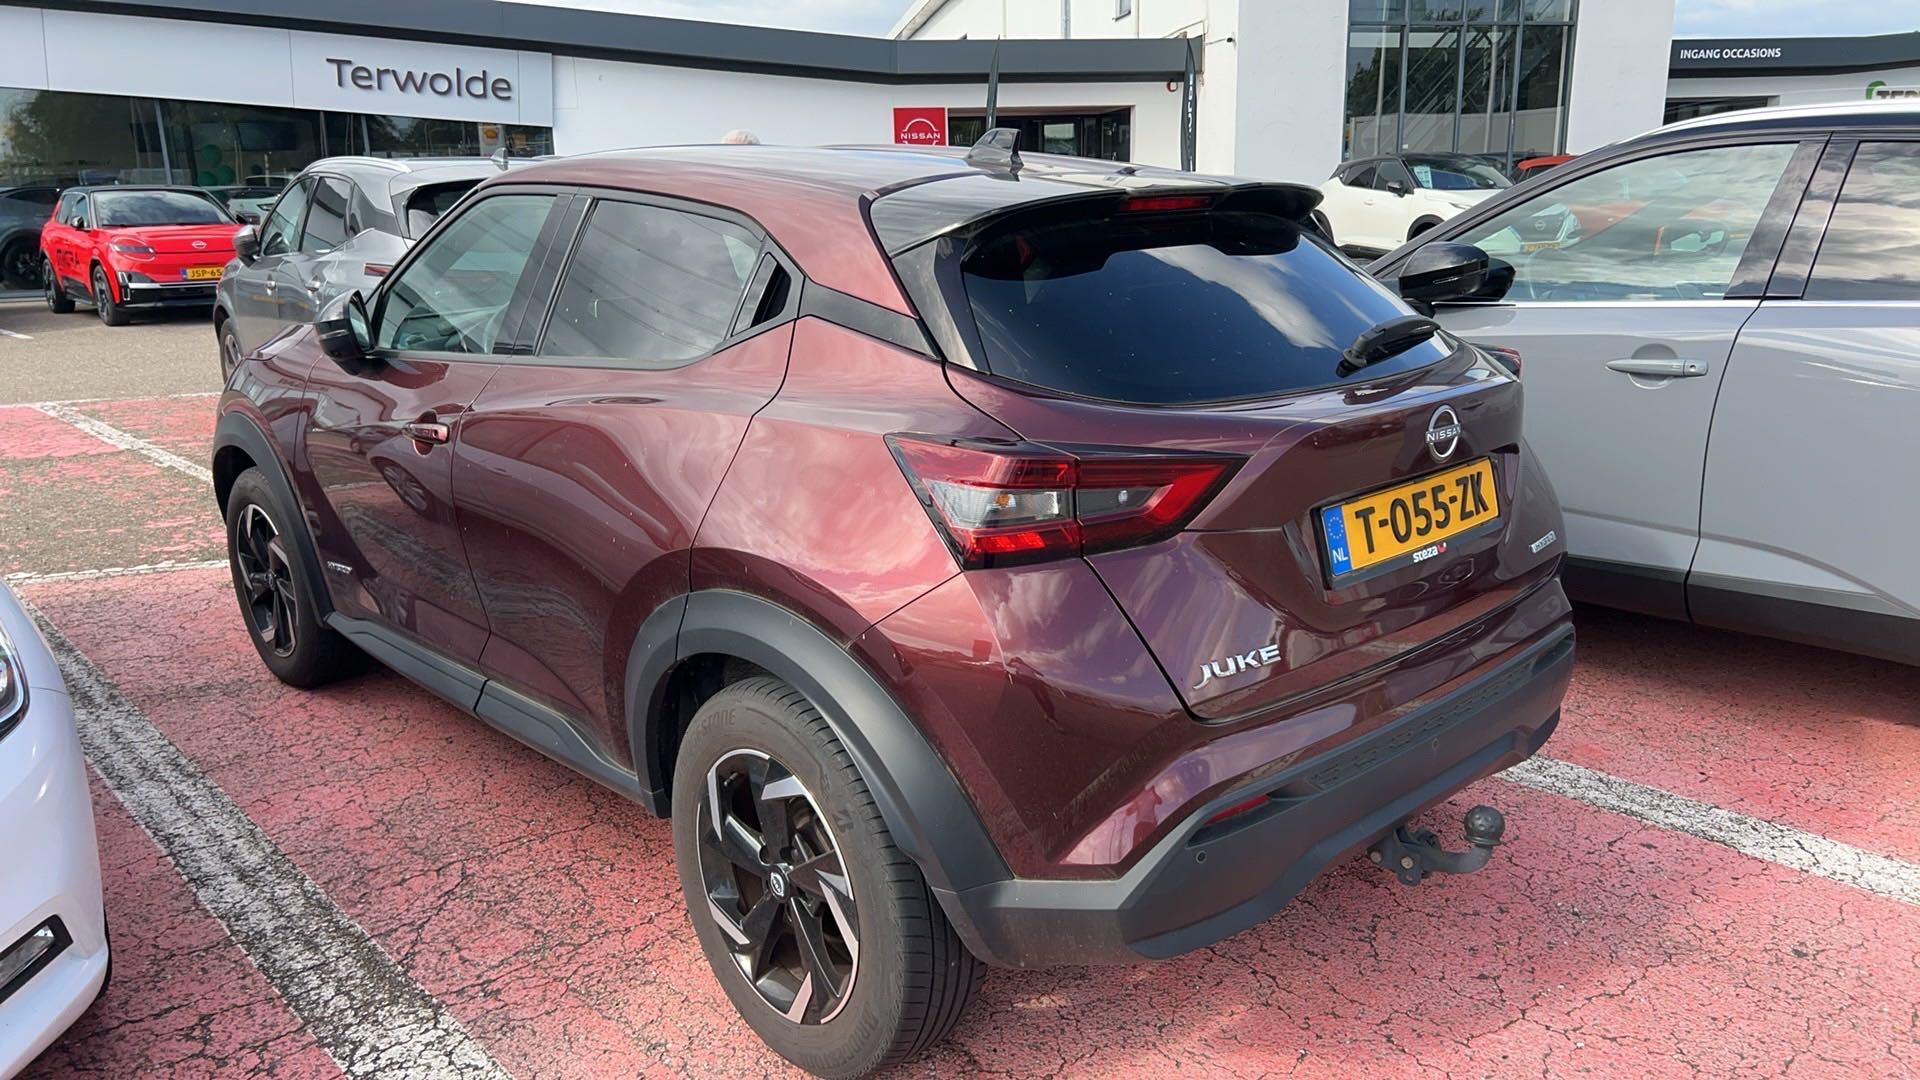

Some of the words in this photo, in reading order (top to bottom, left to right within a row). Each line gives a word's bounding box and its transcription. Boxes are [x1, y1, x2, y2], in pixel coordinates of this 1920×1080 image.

[1680, 49, 1720, 59] INGANG
[1722, 48, 1782, 58] OCCASIONS
[326, 57, 513, 101] Terwolde
[900, 132, 941, 140] NISSAN
[1426, 427, 1461, 442] NISSAN
[1354, 471, 1490, 554] T-055-ZK
[1332, 547, 1349, 564] NL
[1412, 545, 1439, 563] steza
[1192, 644, 1281, 690] JUKE
